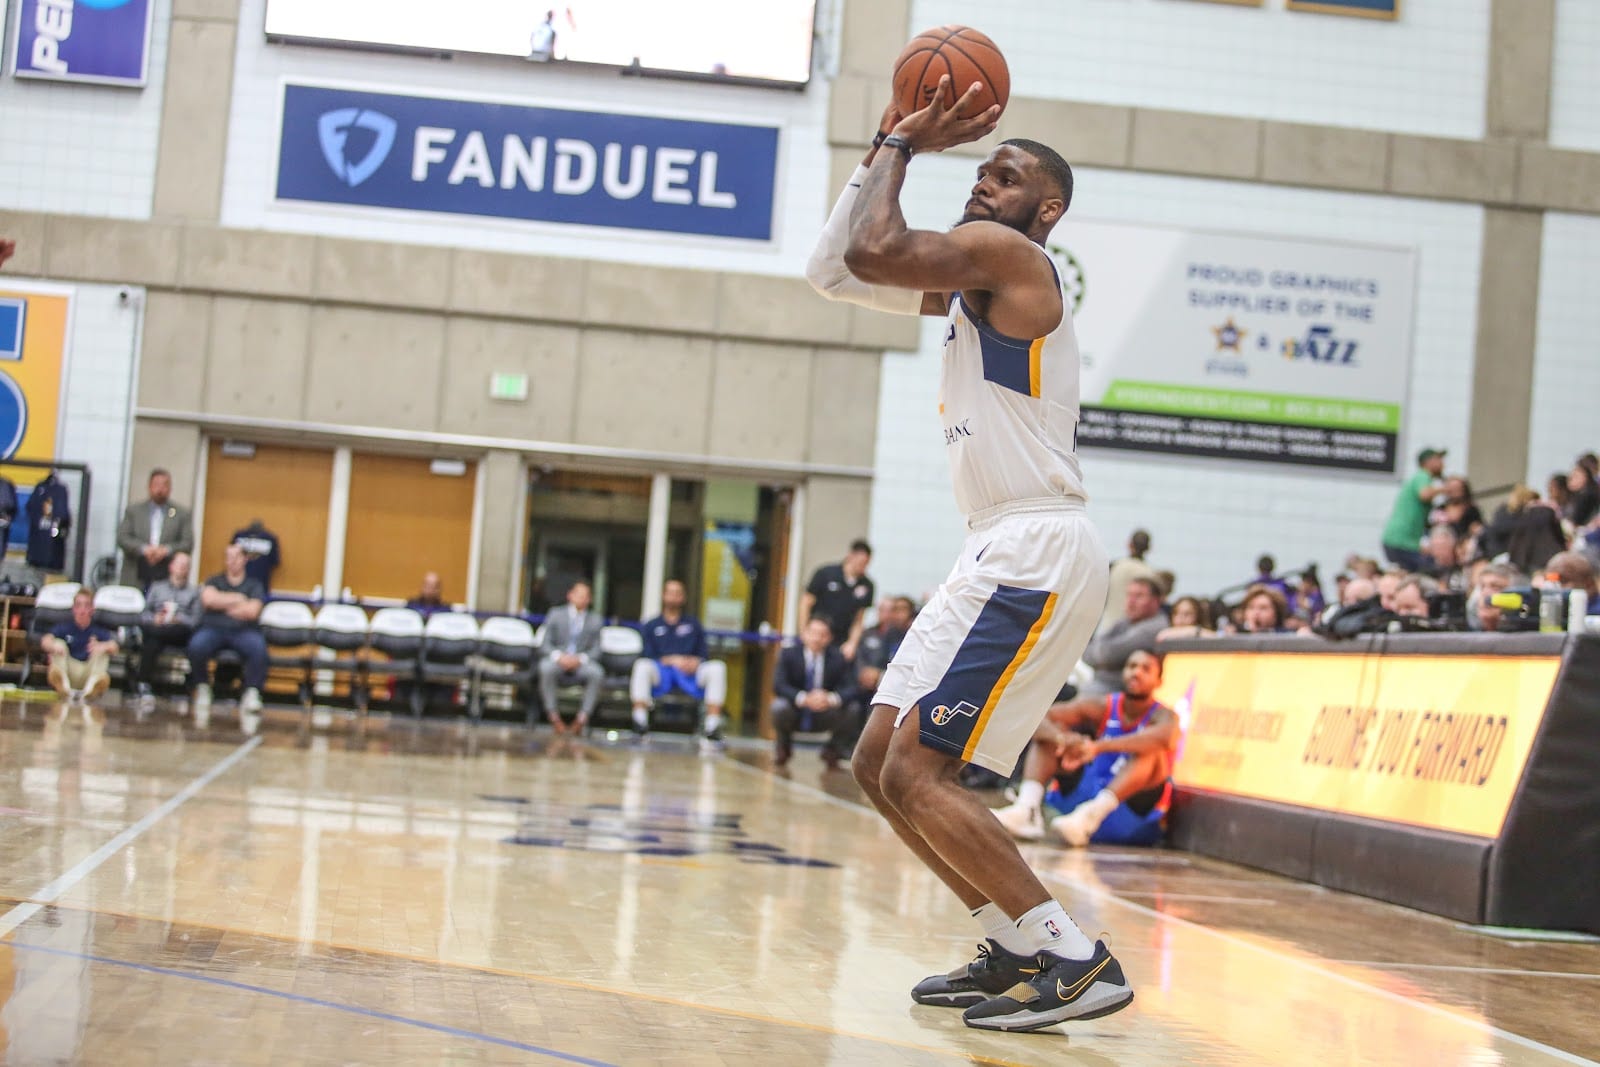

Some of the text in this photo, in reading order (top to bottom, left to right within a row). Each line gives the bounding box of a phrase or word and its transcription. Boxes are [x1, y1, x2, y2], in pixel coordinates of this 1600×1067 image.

[31, 0, 75, 74] PE
[411, 126, 737, 209] FANDUEL
[1188, 263, 1380, 297] PROUD GRAPHICS
[1188, 290, 1375, 323] SUPPLIER OF THE
[1402, 710, 1508, 787] FORWARD
